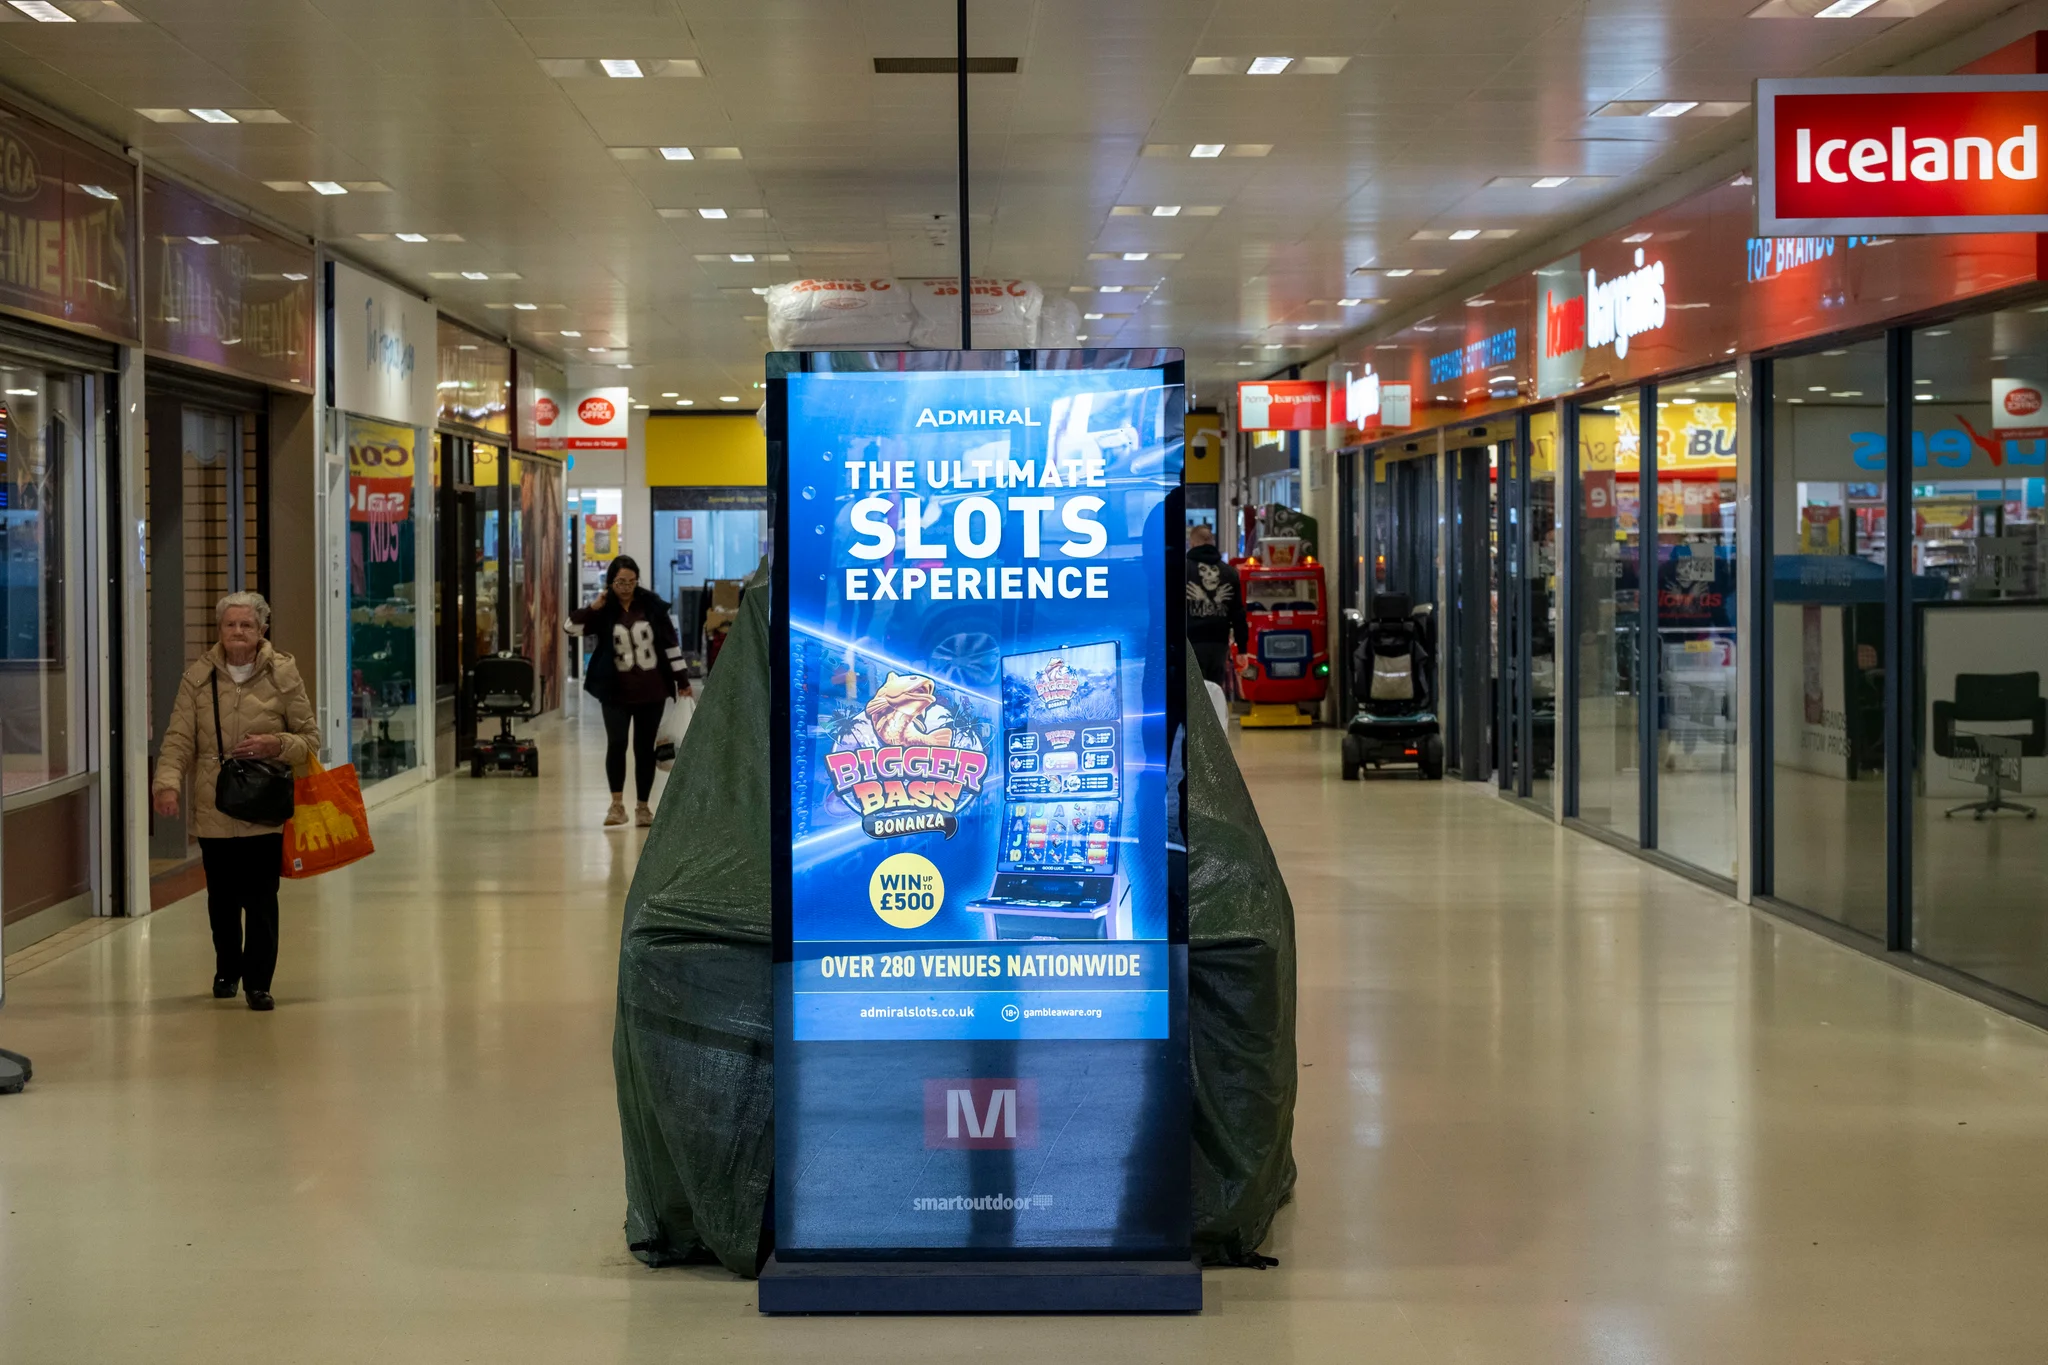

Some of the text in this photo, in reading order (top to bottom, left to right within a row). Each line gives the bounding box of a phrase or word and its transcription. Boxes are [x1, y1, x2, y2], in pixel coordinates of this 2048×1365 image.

[0, 139, 37, 194] GA
[1797, 125, 2038, 184] Iceland
[0, 198, 127, 313] MENTS
[1746, 238, 1773, 282] TOP
[934, 286, 1004, 297] Suer
[1587, 247, 1667, 359] bargains
[581, 410, 611, 419] OFFICE
[585, 402, 608, 411] POST
[1274, 393, 1321, 405] bargains
[915, 407, 1041, 428] ADMIRAL
[845, 459, 1106, 489] THE ULTIMATE
[369, 510, 399, 562] KIDS
[848, 495, 1108, 561] SLOTS
[845, 566, 1109, 601] EXPERIENCE
[612, 620, 658, 672] 98
[826, 746, 986, 791] BIGGER
[854, 780, 963, 816] BASS
[874, 813, 945, 836] BONANZA
[880, 874, 922, 889] WIN
[880, 893, 934, 911] £500
[821, 954, 1141, 978] OVER 280 VENUES NATIONWIDE
[860, 1005, 975, 1018] admiralslots.co.uk
[1023, 1007, 1102, 1019] gambleaware.org
[946, 1089, 1017, 1138] M
[913, 1193, 1032, 1211] smartoutdoor
